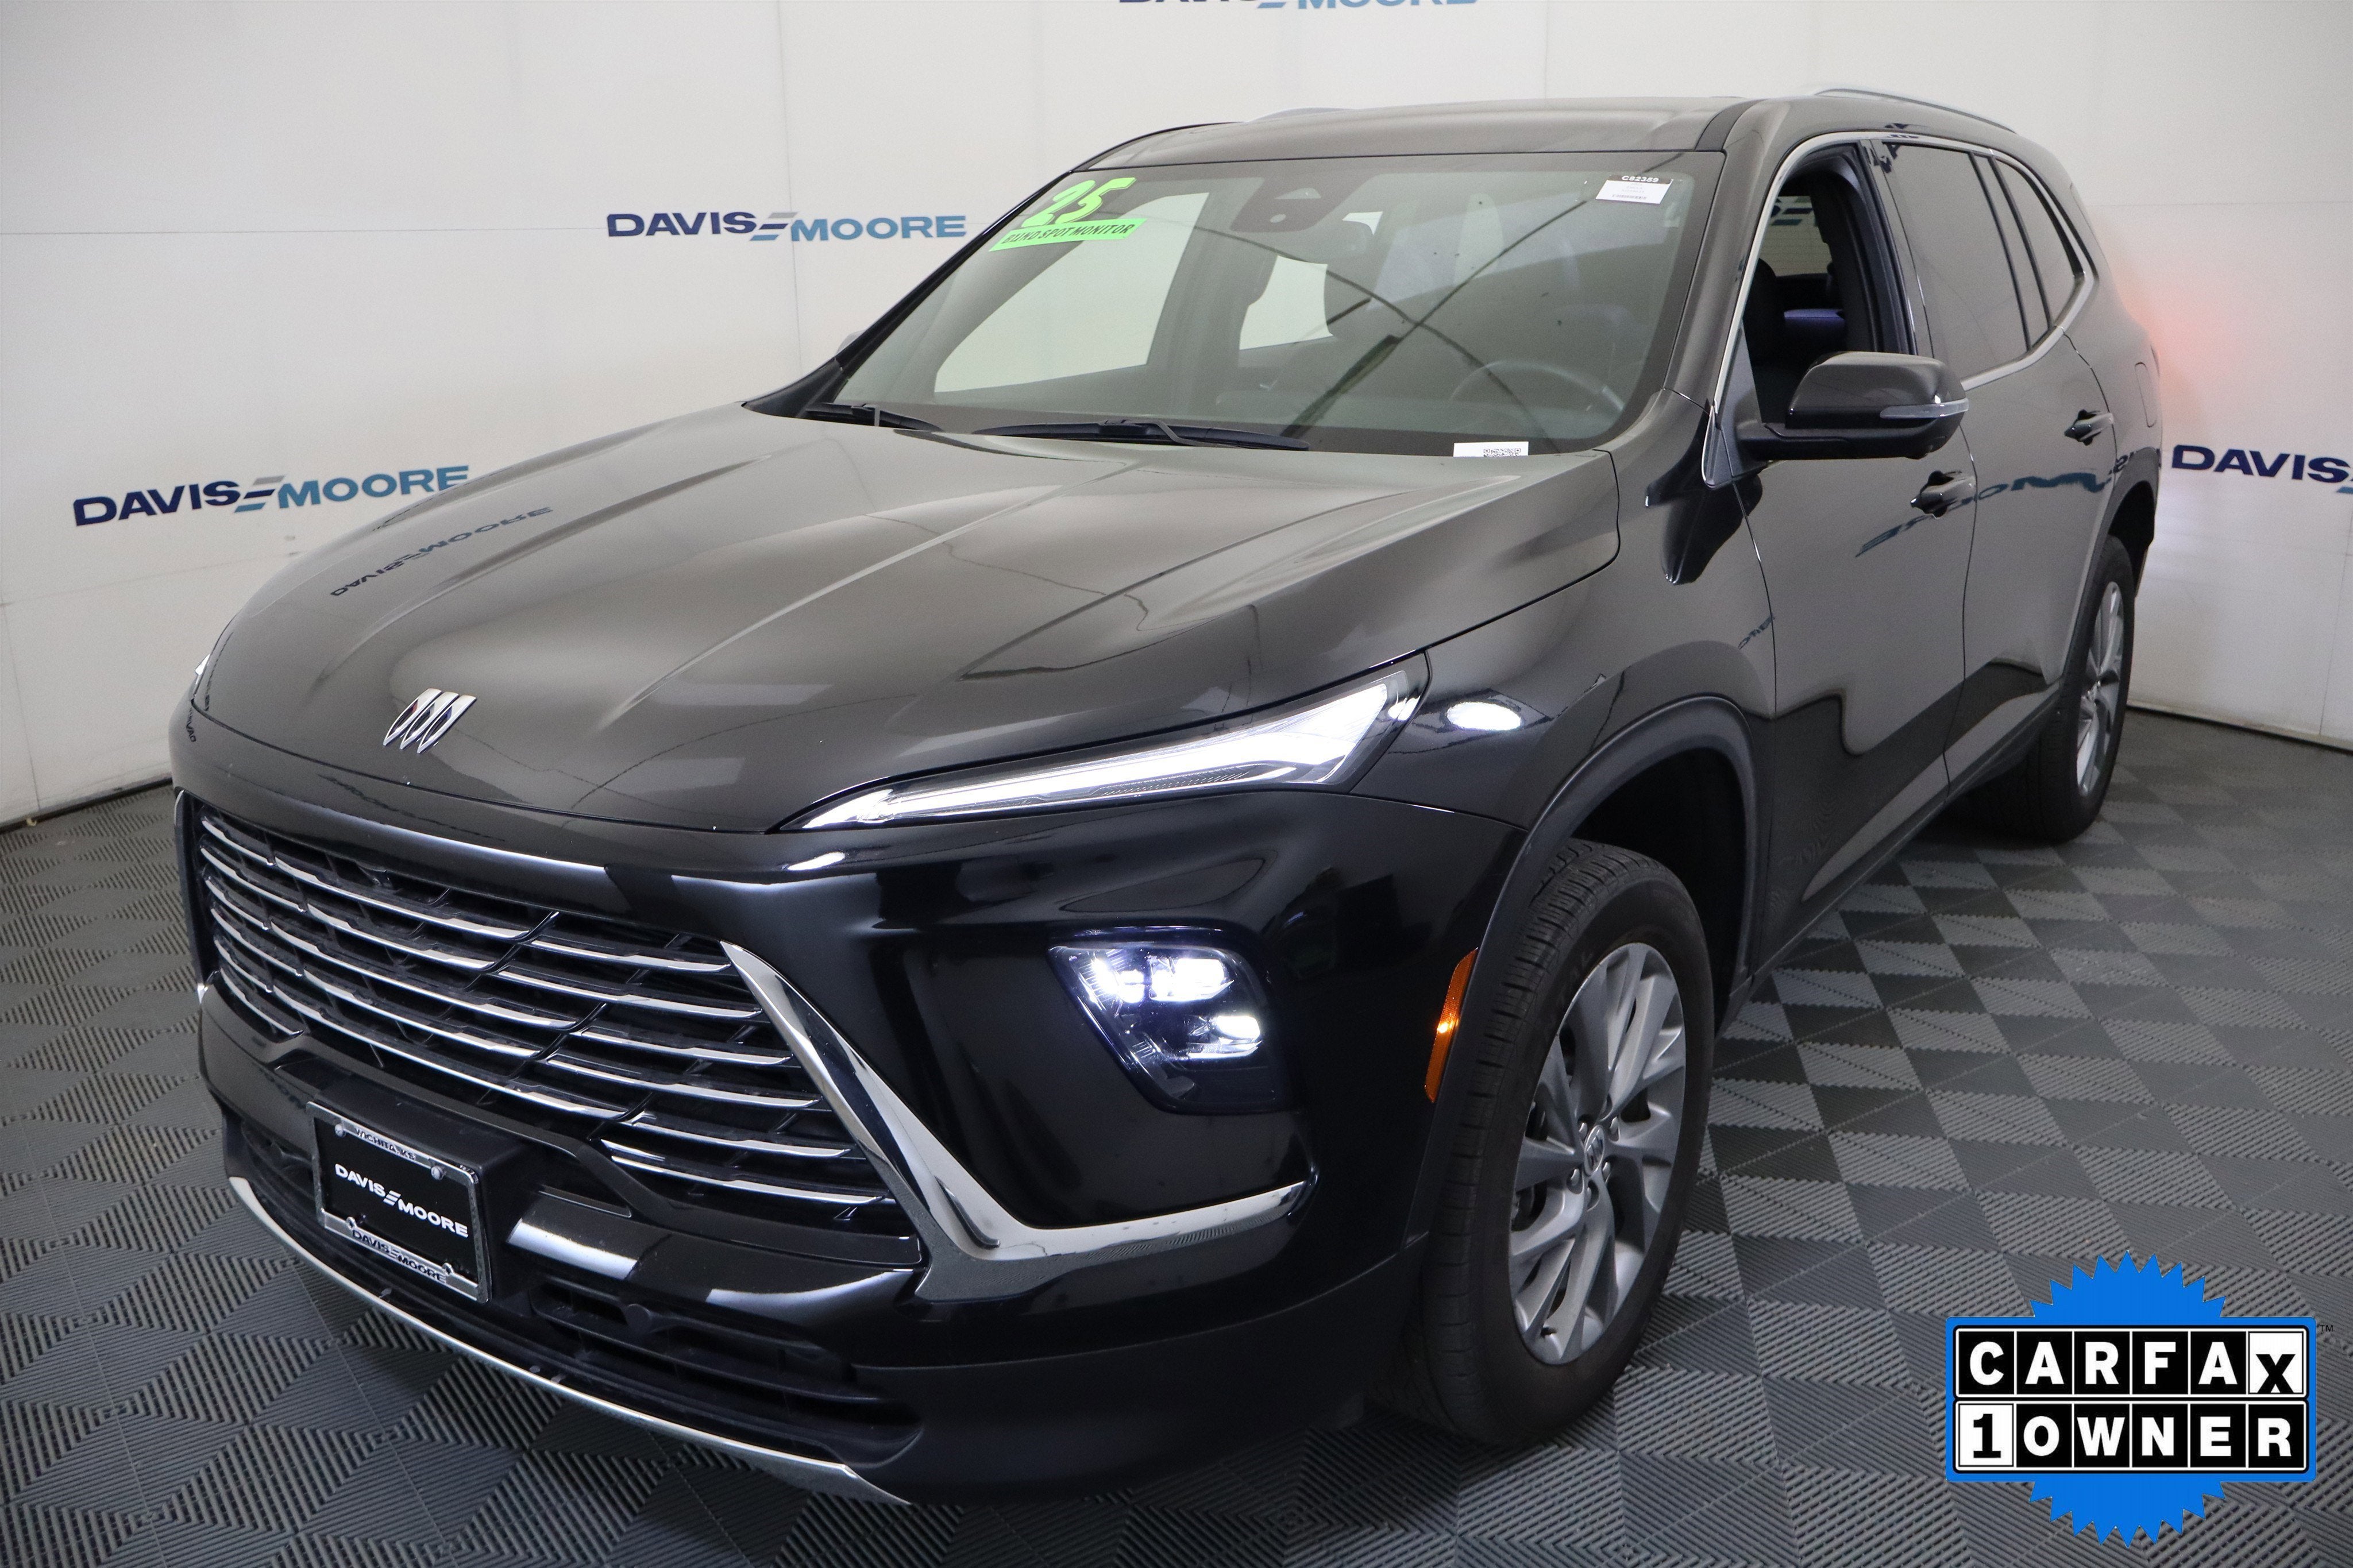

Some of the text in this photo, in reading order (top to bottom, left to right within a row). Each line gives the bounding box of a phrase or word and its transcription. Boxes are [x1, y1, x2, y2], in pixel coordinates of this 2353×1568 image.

[606, 211, 967, 242] DAVIS MOORE
[1020, 176, 1137, 228] 25
[1000, 224, 1136, 244] BLIND SPOT MONITOR
[2171, 444, 2350, 484] DAVIS
[72, 465, 469, 527] DAVIS MOORE
[334, 1163, 469, 1238] DAVIS MOORE
[352, 1229, 447, 1284] DAVIS MOORE
